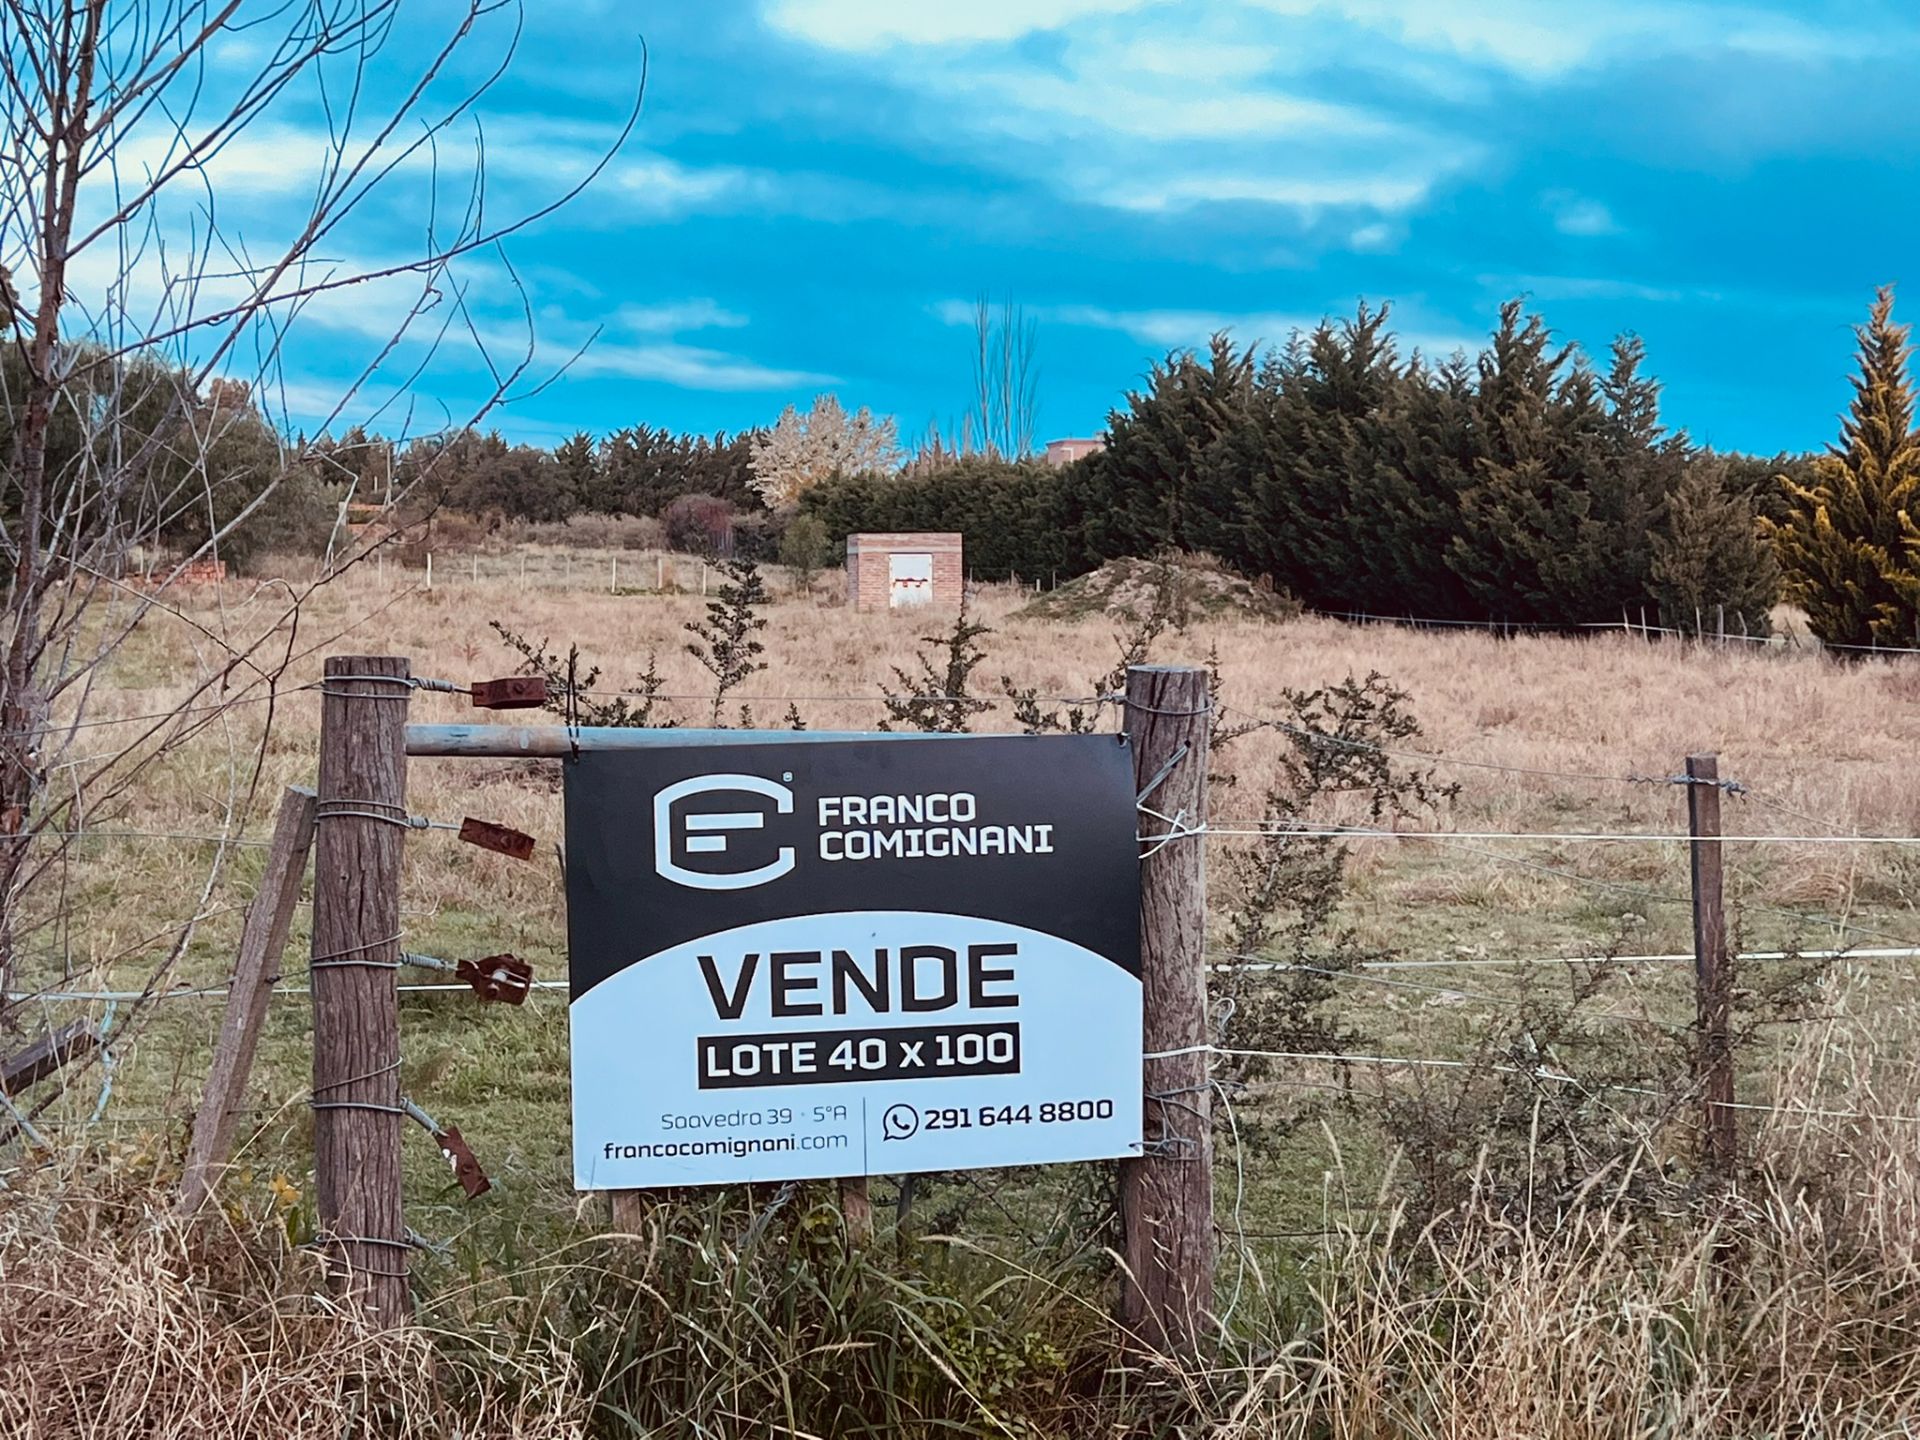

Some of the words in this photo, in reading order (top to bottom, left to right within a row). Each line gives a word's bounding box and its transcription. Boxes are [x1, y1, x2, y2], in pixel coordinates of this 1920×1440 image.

[818, 792, 976, 826] FRANCO
[819, 824, 1054, 861] COMIGNANI
[697, 943, 1019, 1020] VENDE
[707, 1041, 817, 1077] LOTE
[828, 1038, 887, 1071] 40
[936, 1032, 1014, 1066] 100
[661, 1109, 762, 1130] Saavedra
[766, 1107, 793, 1125] 39
[924, 1108, 972, 1130] 291
[979, 1105, 1032, 1126] 644
[1039, 1099, 1113, 1123] 8800
[603, 1134, 848, 1159] francocomignani.com
